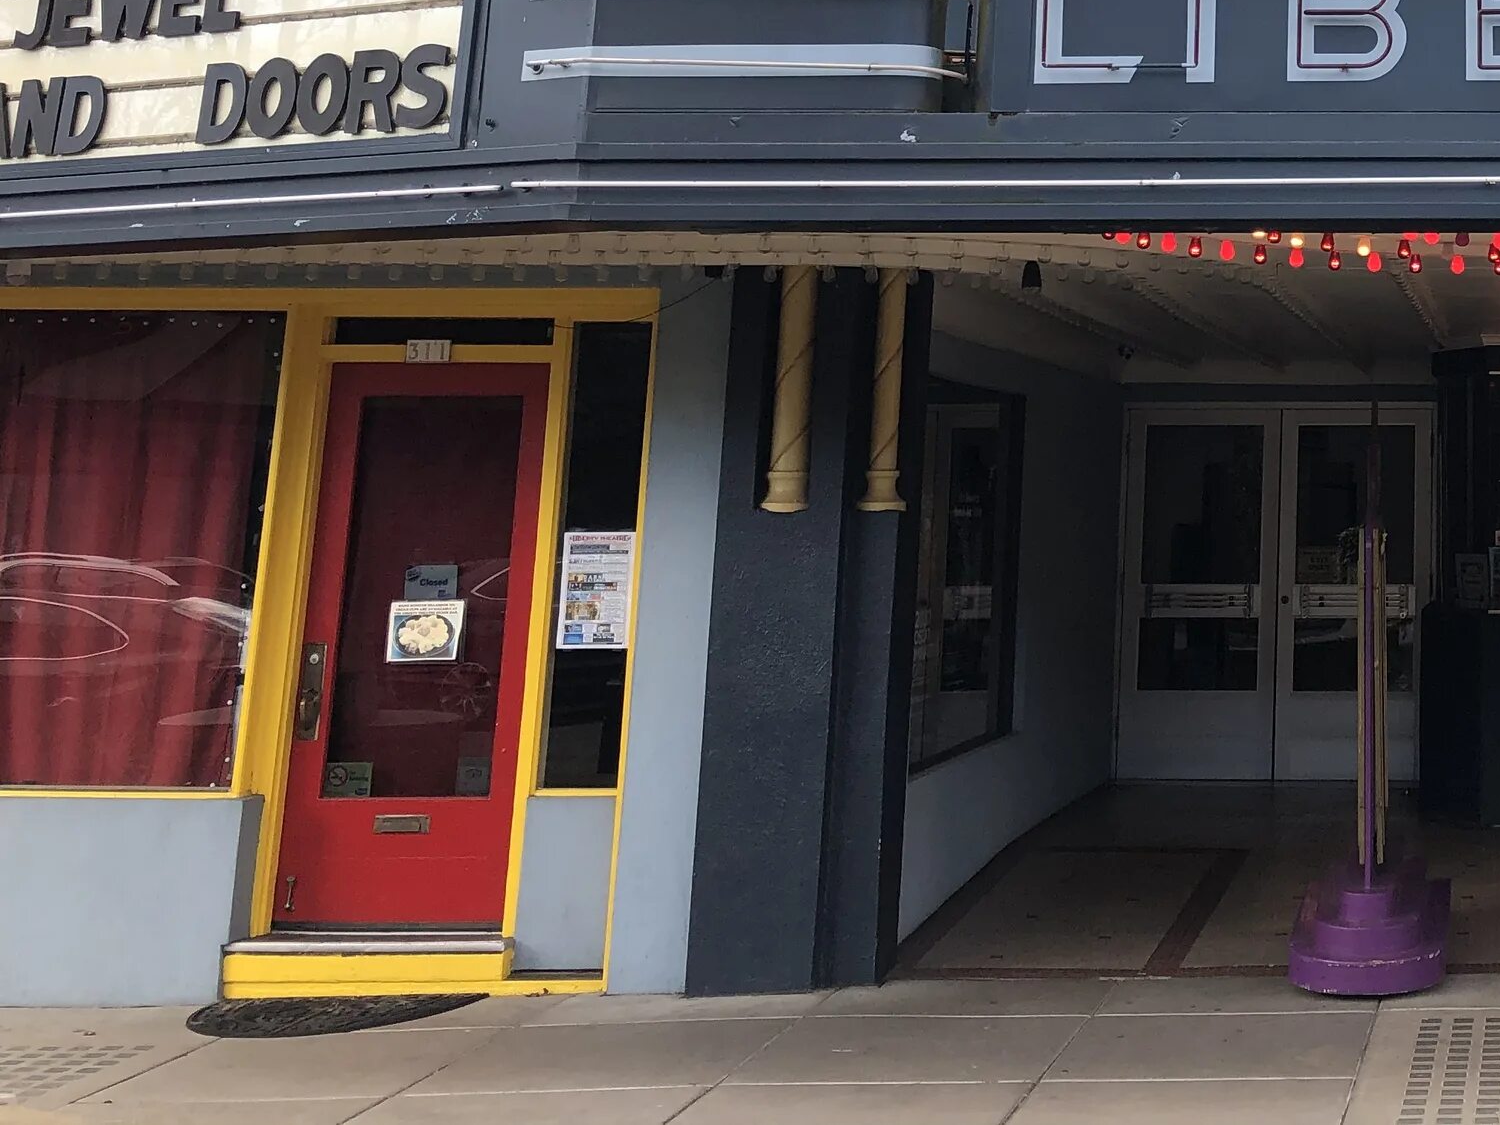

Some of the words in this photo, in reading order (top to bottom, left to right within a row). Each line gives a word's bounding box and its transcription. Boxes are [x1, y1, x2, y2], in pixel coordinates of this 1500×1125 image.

[0, 75, 108, 159] ND
[195, 44, 452, 145] DOORS
[408, 342, 445, 360] 311
[419, 578, 449, 587] Closed
